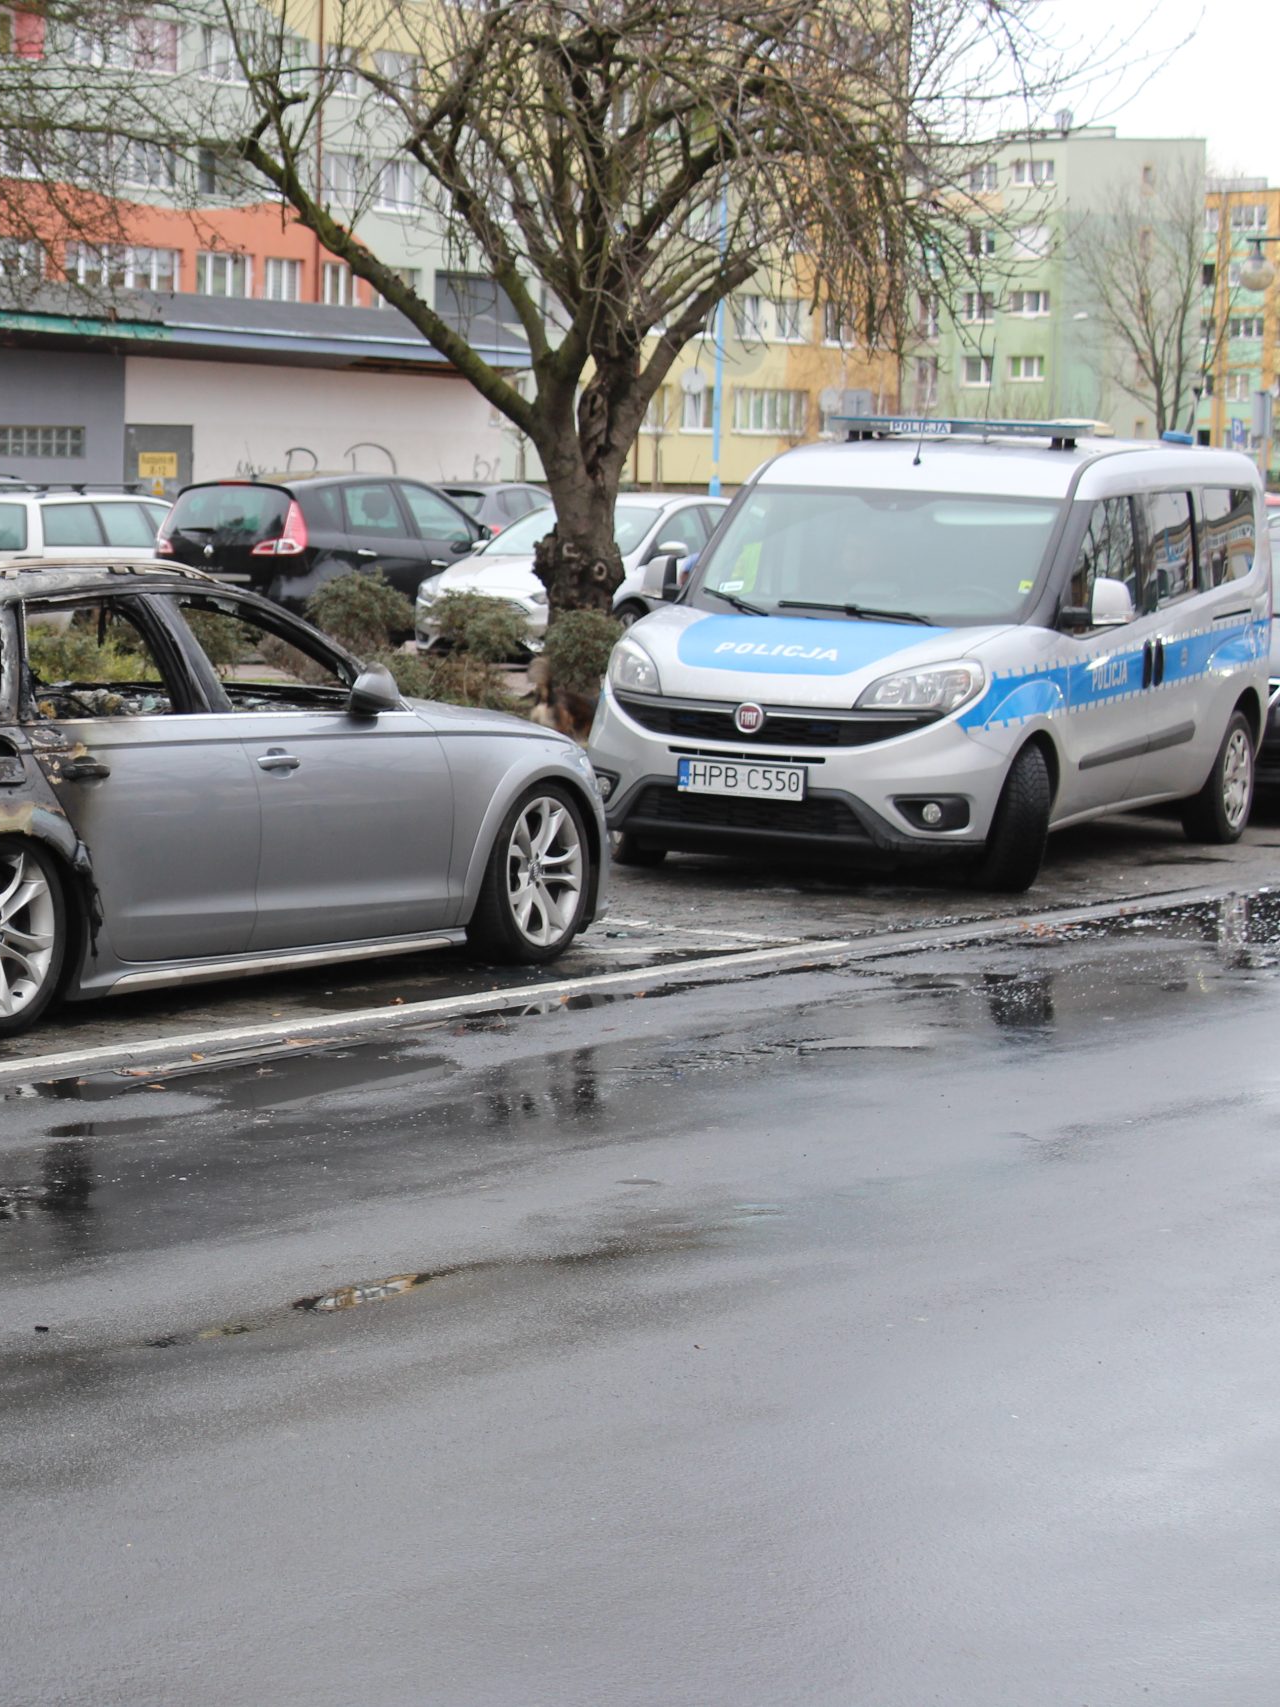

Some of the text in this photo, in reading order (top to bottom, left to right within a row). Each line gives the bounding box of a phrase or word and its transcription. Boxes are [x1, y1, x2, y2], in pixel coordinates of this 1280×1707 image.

[892, 421, 949, 434] POLICJA
[713, 641, 839, 661] POLICJA
[1091, 659, 1128, 692] POLICJA
[740, 711, 758, 727] FIAT
[680, 775, 688, 784] PL
[692, 763, 800, 793] HPB C550
